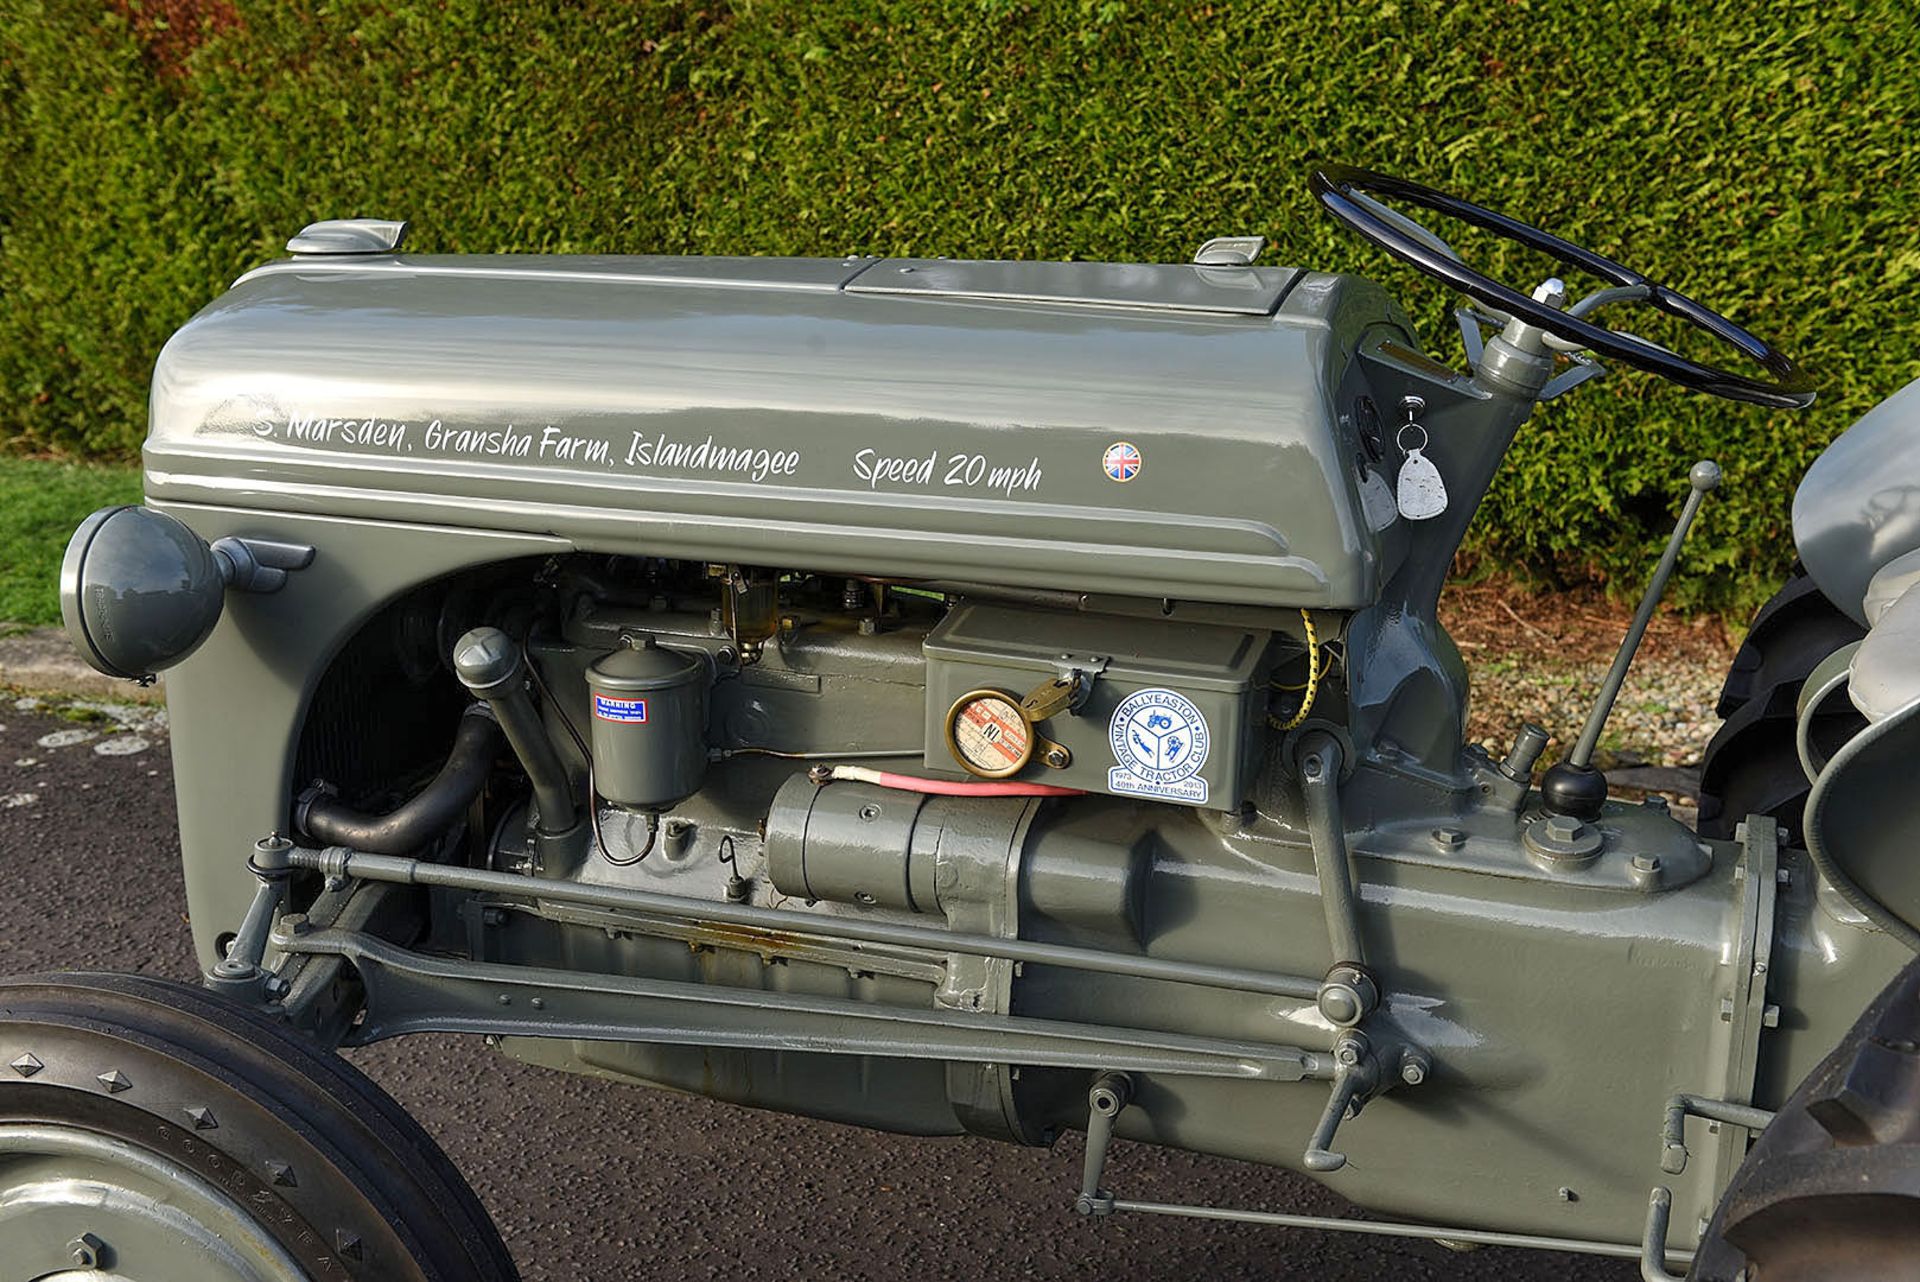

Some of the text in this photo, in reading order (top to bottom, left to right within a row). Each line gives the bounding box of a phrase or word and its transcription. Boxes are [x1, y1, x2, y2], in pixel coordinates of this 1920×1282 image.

[286, 411, 413, 452] Marsden,
[425, 419, 532, 457] Gransha
[539, 425, 614, 468] Farm,
[624, 430, 800, 482] Islandmagee
[853, 448, 1042, 497] Speed 20 mph
[1121, 694, 1198, 725] BALLYEASTON
[983, 723, 1000, 741] NI
[1115, 723, 1204, 781] VINTAGE TRACTOR CLUB
[1115, 771, 1132, 780] 1973
[1137, 784, 1202, 797] ANNIVERSARY
